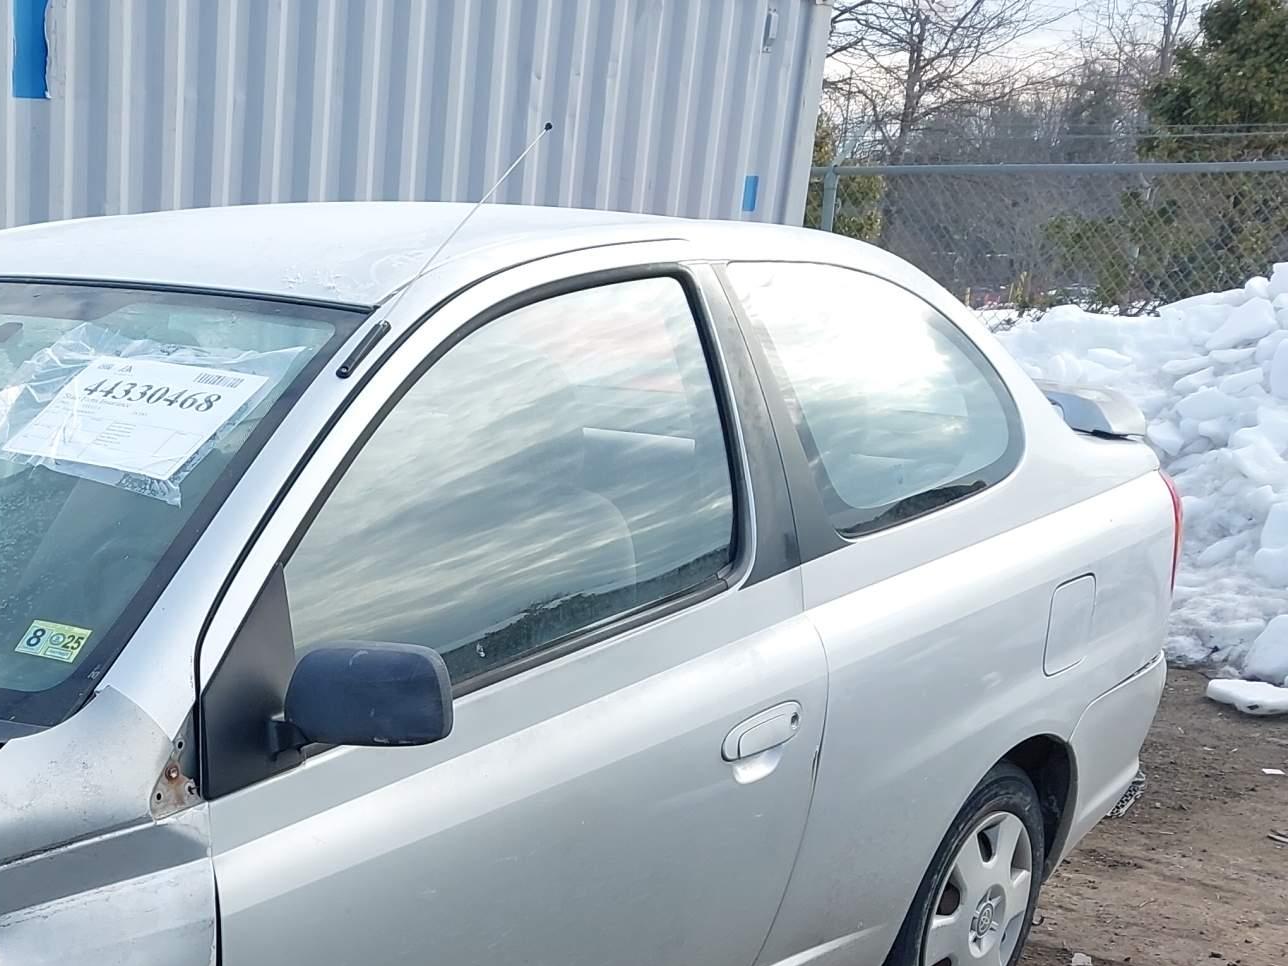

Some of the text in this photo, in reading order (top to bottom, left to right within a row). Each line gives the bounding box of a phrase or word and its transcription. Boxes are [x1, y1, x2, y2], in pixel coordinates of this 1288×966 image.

[83, 378, 222, 412] 44330468
[26, 628, 46, 647] 8
[61, 634, 85, 651] 25
